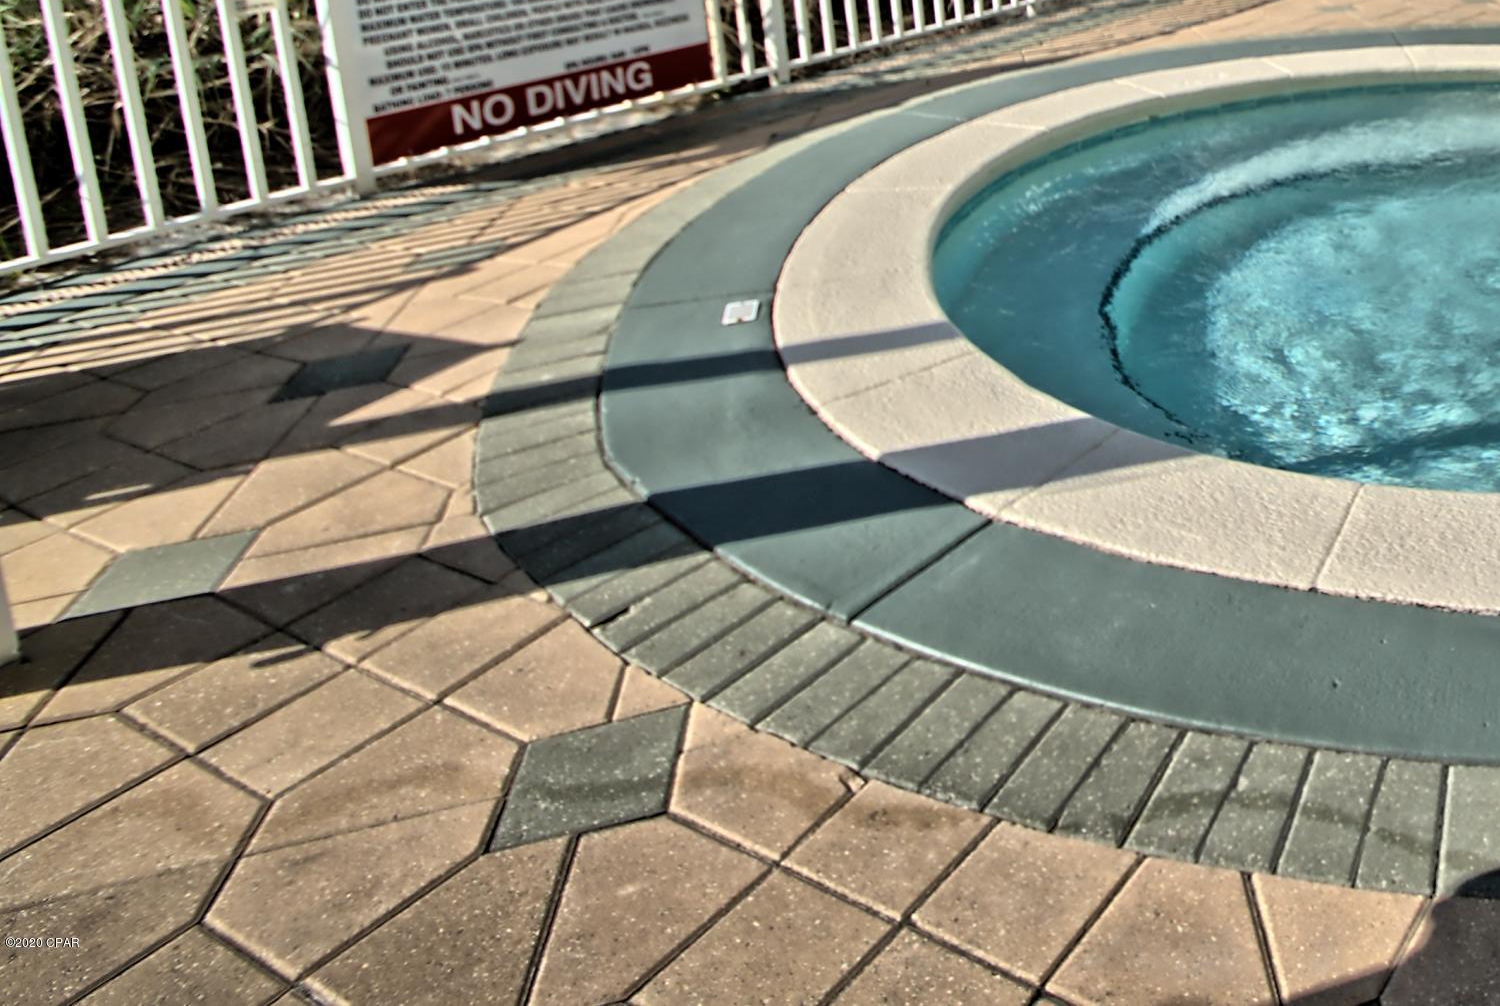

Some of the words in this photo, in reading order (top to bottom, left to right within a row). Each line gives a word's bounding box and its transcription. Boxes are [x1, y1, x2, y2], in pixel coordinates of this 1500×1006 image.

[358, 7, 373, 19] DO
[375, 3, 394, 16] NOT
[451, 94, 515, 135] NO
[526, 62, 654, 117] DIVING
